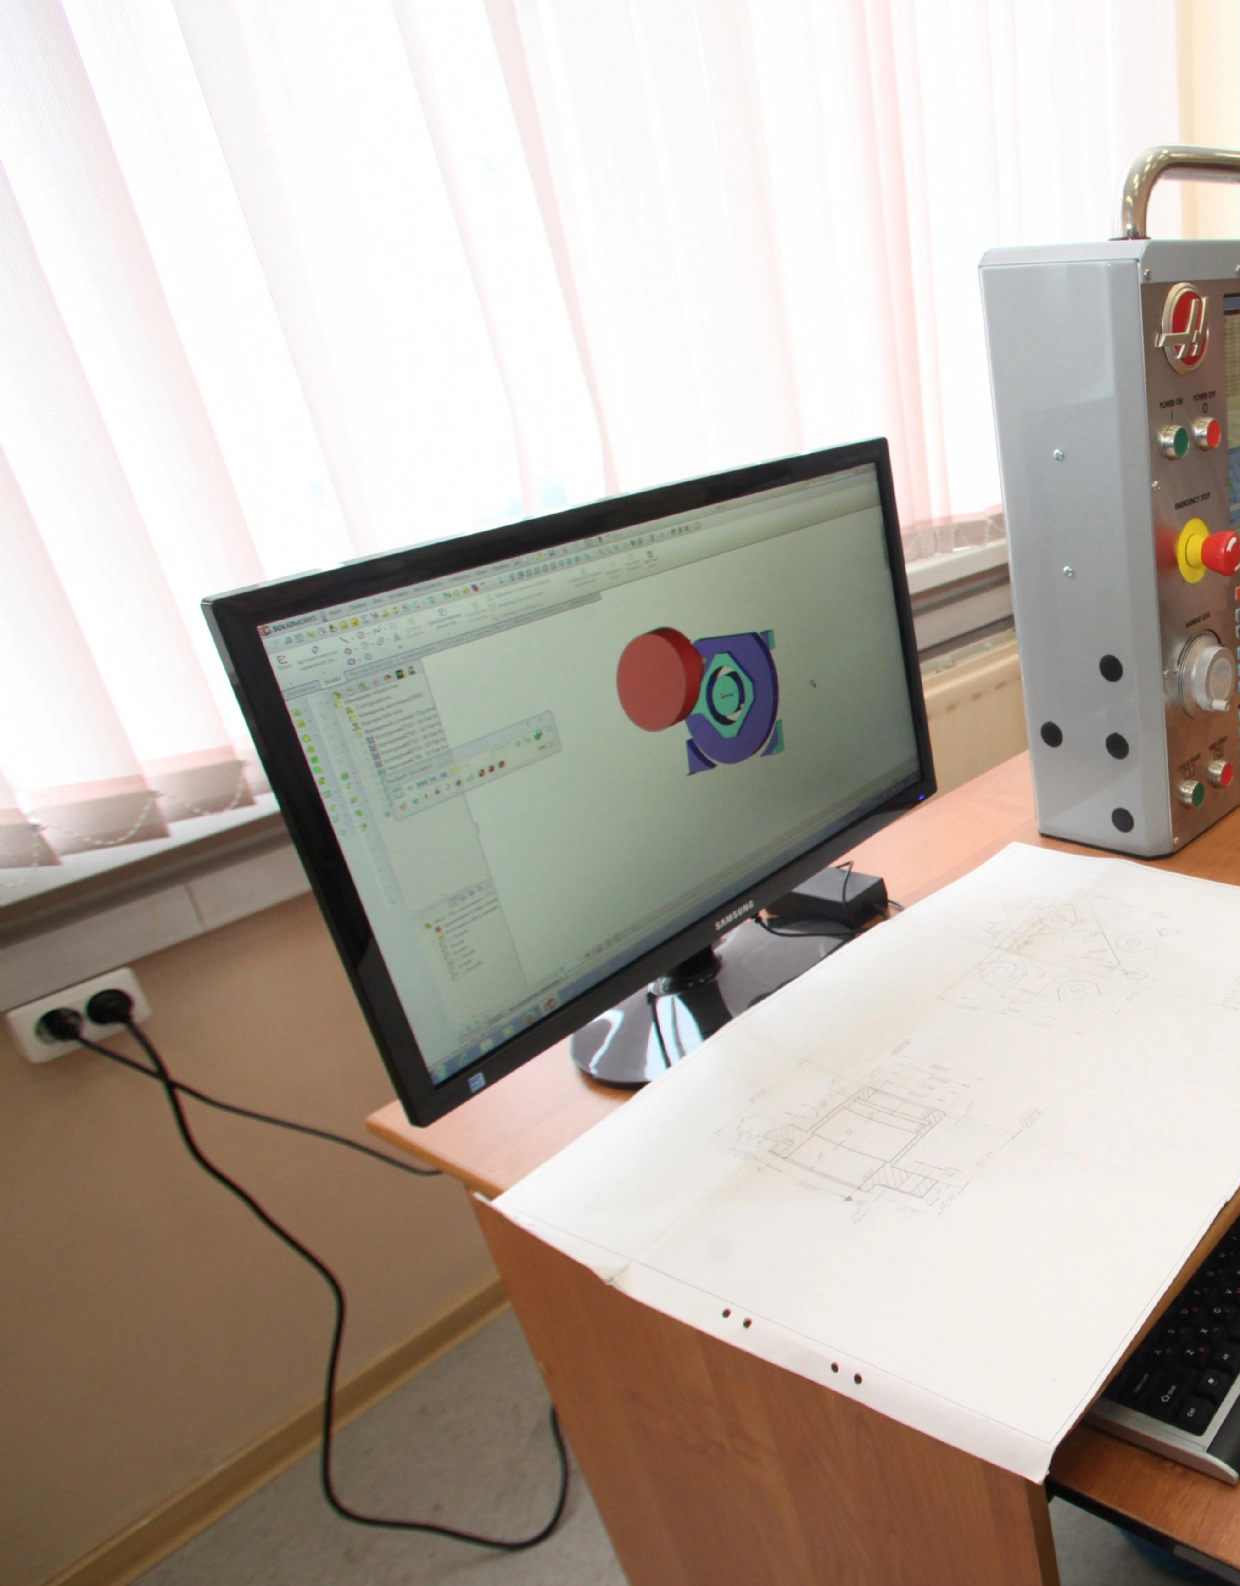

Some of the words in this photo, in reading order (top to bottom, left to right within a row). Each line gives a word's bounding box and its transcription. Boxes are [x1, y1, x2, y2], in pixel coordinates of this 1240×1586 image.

[1193, 392, 1207, 401] POWER
[1208, 390, 1216, 399] OFF
[1159, 399, 1175, 409] POWER
[1174, 496, 1200, 510] EMERGENCY
[1200, 492, 1211, 502] STOP
[272, 614, 318, 633] SOLIDWORKS
[715, 900, 754, 930] SAMSUNG
[1187, 1407, 1196, 1417] Ctrl
